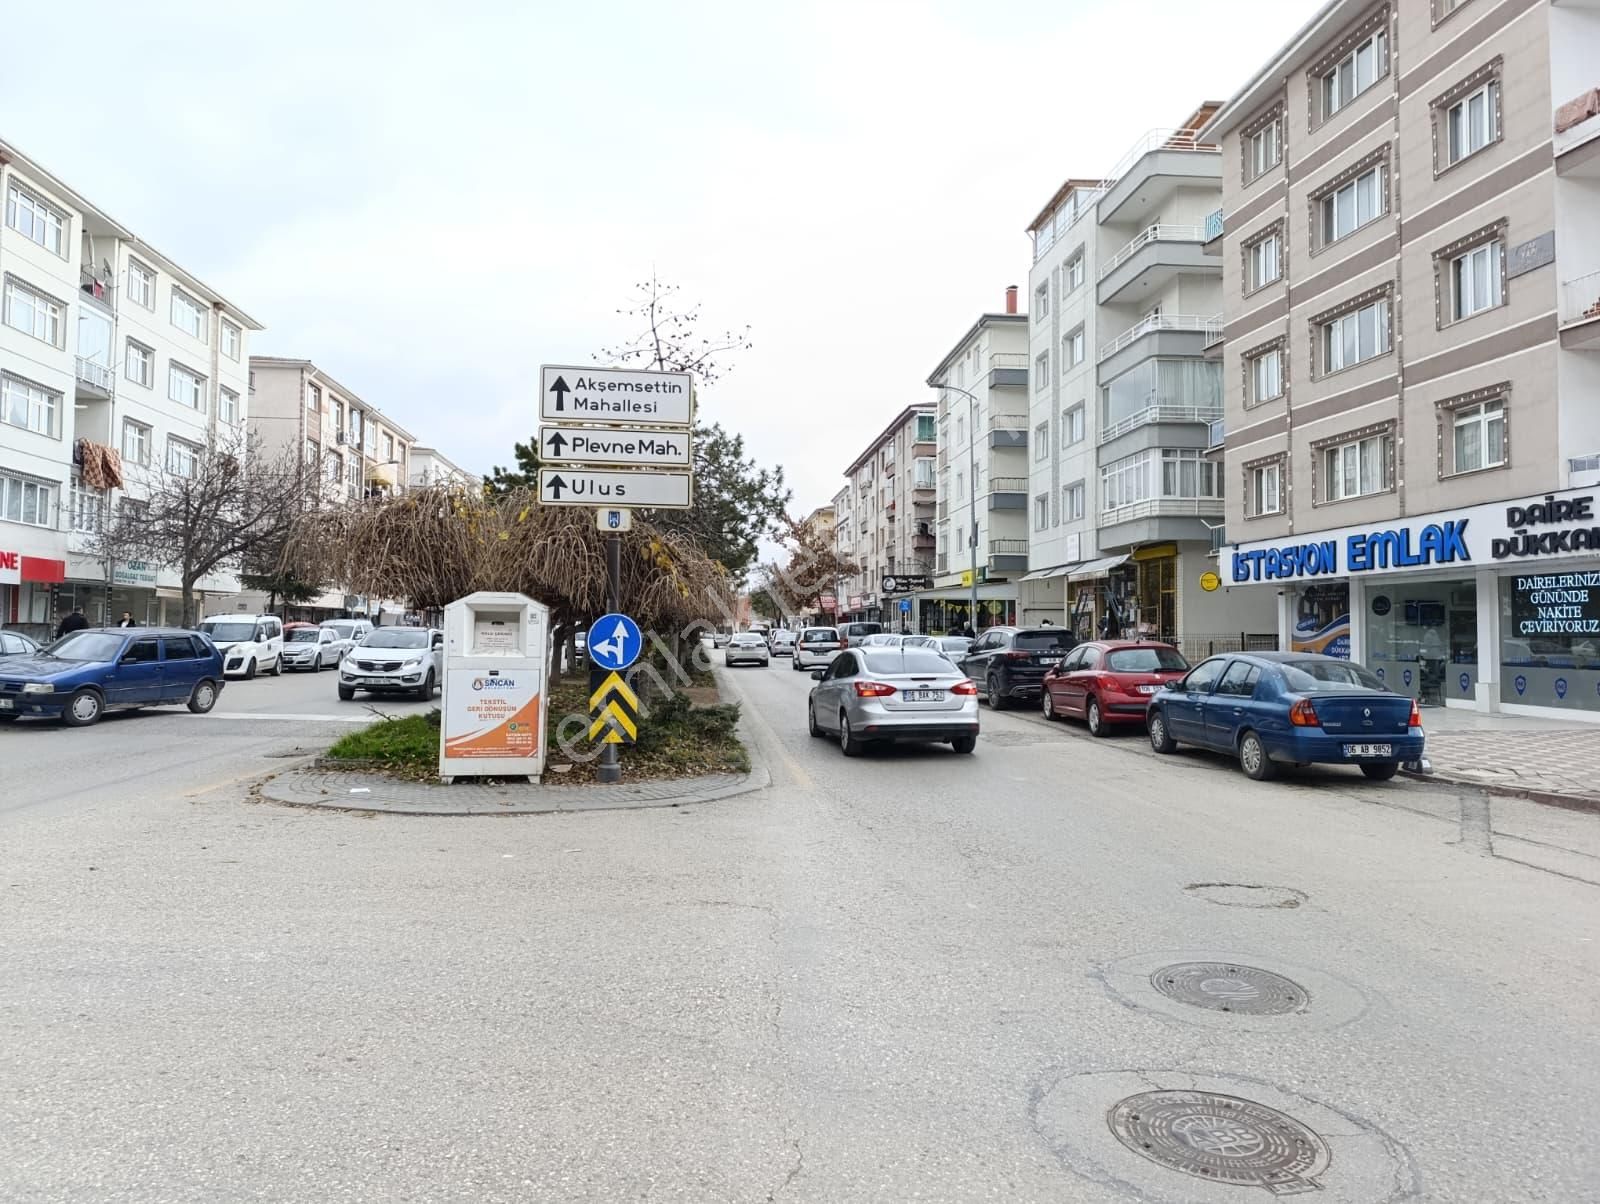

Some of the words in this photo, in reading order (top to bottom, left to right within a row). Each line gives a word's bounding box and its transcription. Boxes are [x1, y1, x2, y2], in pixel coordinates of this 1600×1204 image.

[575, 377, 682, 393] Akşemsettin
[574, 397, 657, 413] Mahallesi
[572, 437, 636, 454] Plevne
[638, 440, 682, 456] Mah.
[572, 479, 626, 496] Ulus
[1506, 495, 1594, 529] DAİRE
[1232, 540, 1336, 582] İSTASYON
[1347, 518, 1471, 571] EMLAK
[1530, 589, 1589, 604] GÜNÜNDE
[1538, 604, 1582, 619] NAKİTE
[1520, 618, 1600, 635] ÇEVİRİYORUZ
[1361, 745, 1370, 754] AB
